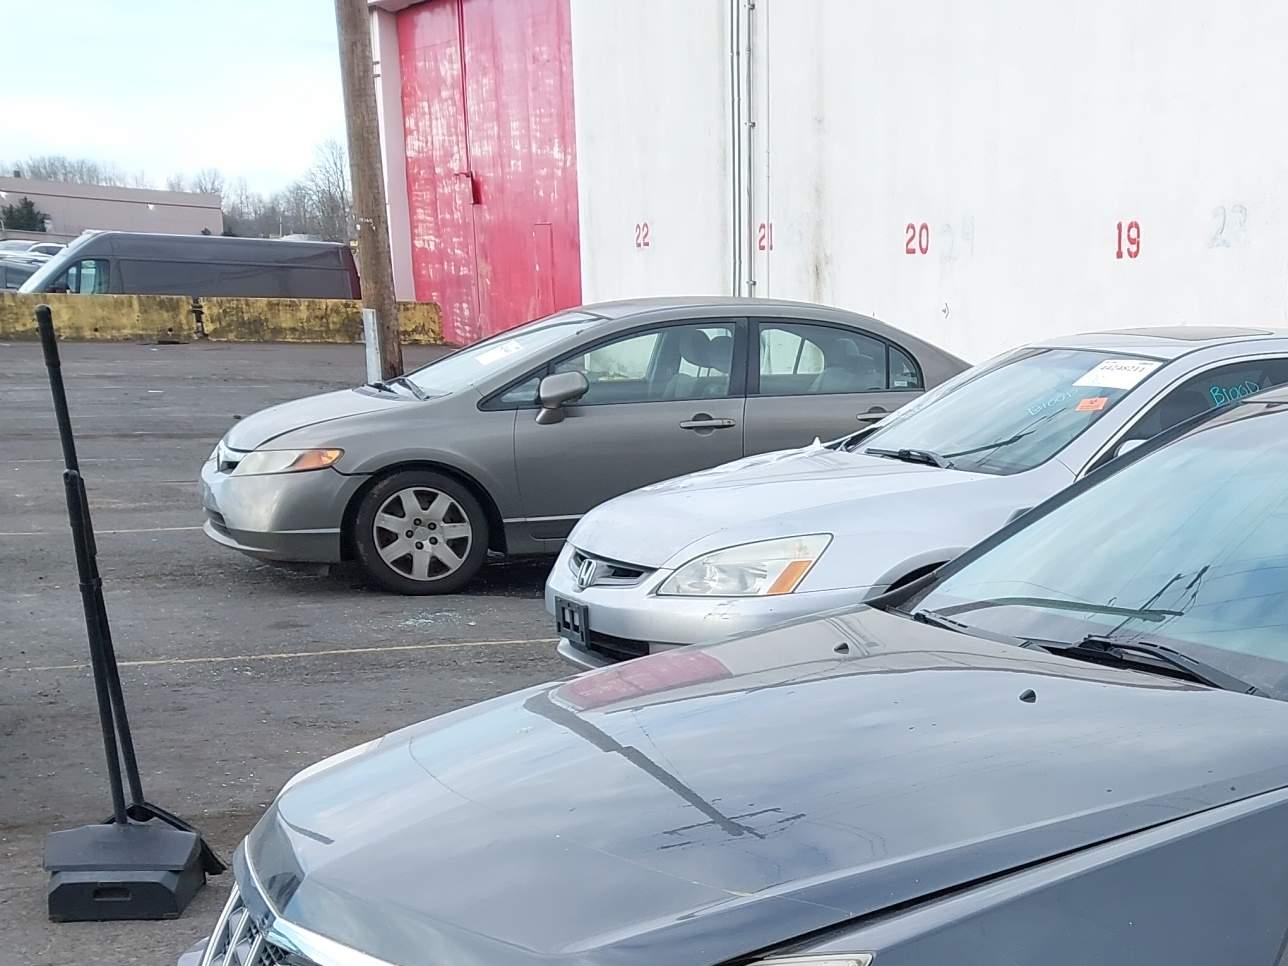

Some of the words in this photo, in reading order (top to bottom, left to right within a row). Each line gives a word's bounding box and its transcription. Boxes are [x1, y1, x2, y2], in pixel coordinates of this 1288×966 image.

[635, 222, 650, 248] 22
[758, 223, 773, 251] 21
[905, 222, 930, 255] 20
[1115, 221, 1141, 259] 19
